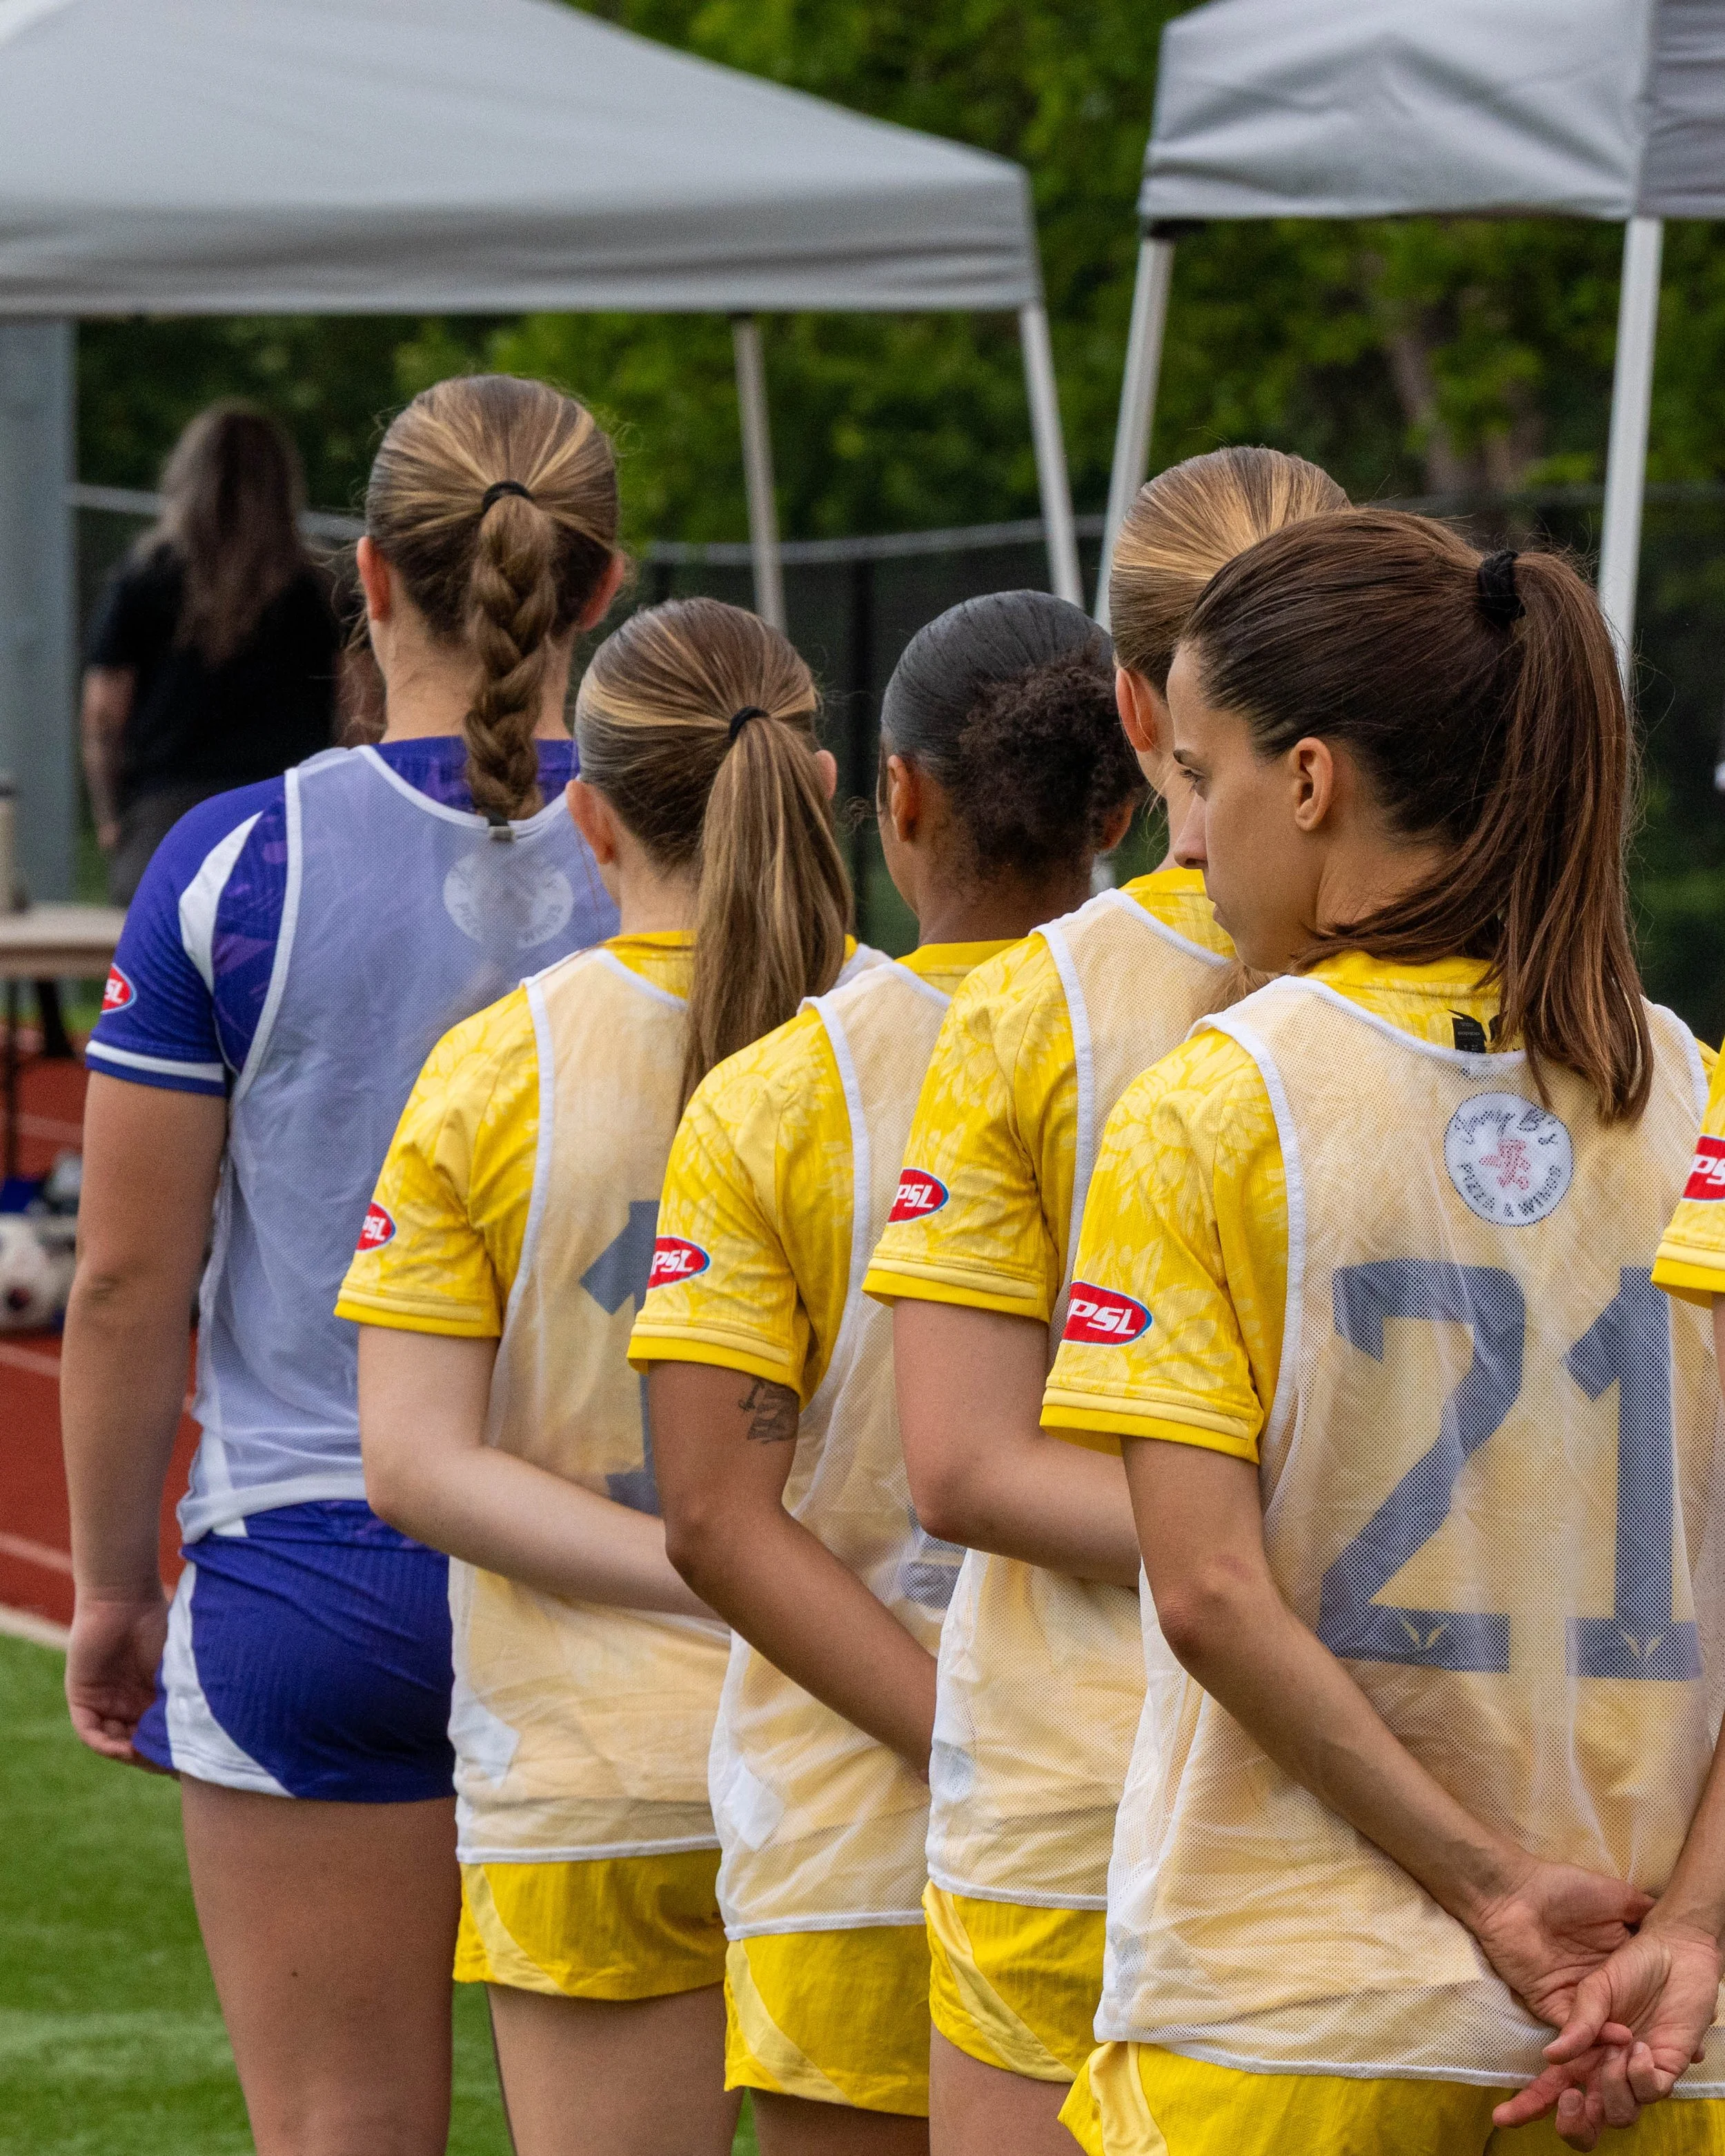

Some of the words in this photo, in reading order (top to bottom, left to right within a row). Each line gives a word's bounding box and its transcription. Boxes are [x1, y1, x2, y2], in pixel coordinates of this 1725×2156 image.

[651, 1249, 694, 1276] PSL
[1066, 1298, 1136, 1335] PSL
[1318, 1258, 1703, 1681] 21
